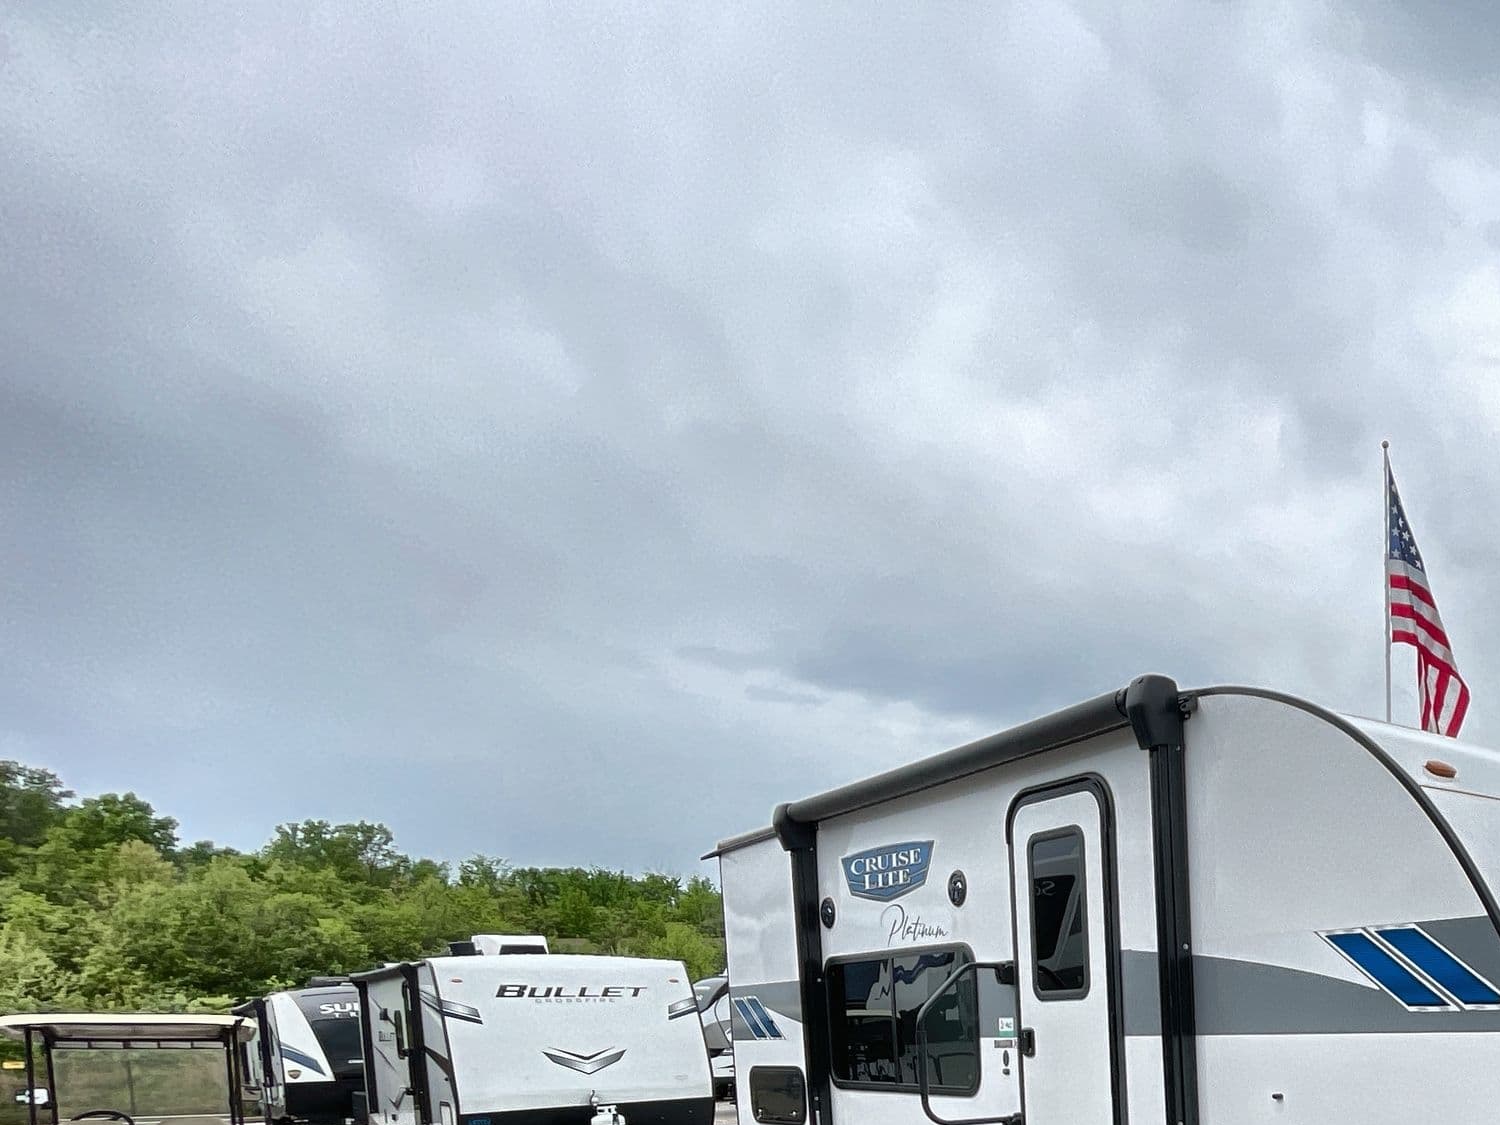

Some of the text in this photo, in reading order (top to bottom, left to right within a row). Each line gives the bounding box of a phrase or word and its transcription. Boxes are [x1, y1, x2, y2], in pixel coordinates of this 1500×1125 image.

[850, 848, 922, 875] CRUISE
[864, 869, 911, 890] LITE
[881, 904, 949, 948] Platinum
